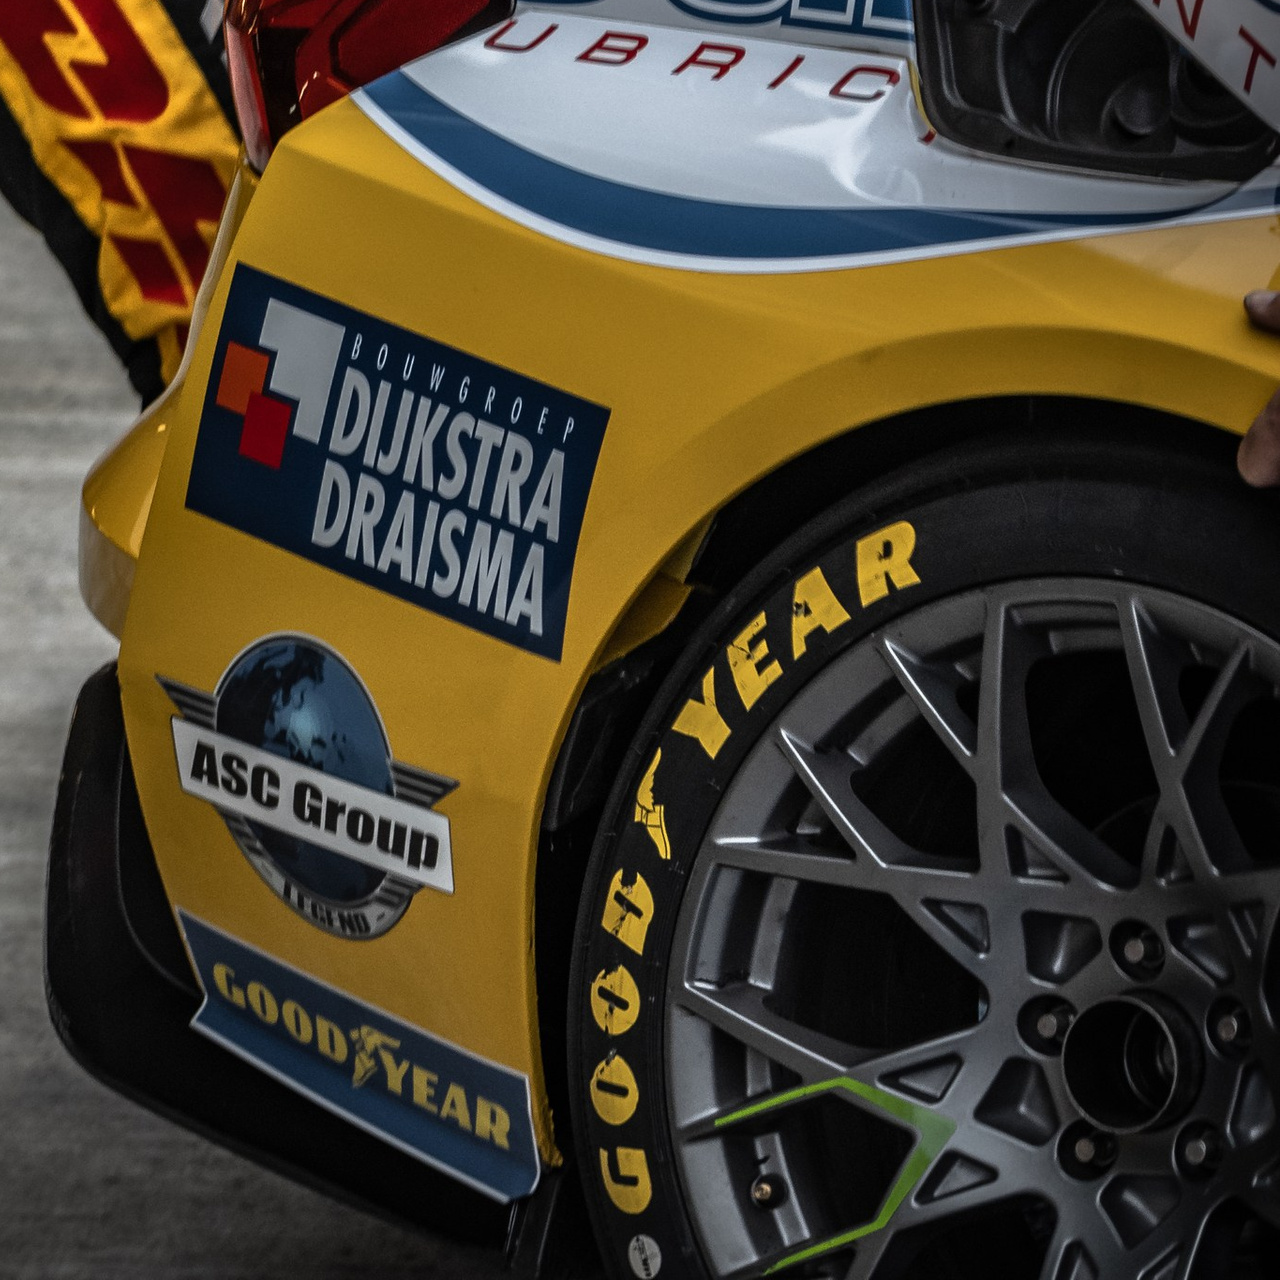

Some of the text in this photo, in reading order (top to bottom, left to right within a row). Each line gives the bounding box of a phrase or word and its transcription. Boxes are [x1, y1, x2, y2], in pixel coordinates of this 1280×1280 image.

[328, 365, 565, 544] DIJKSTRA
[350, 332, 575, 444] BOUWGROEP
[310, 458, 544, 637] DRAISMA
[189, 740, 440, 872] ASC Group
